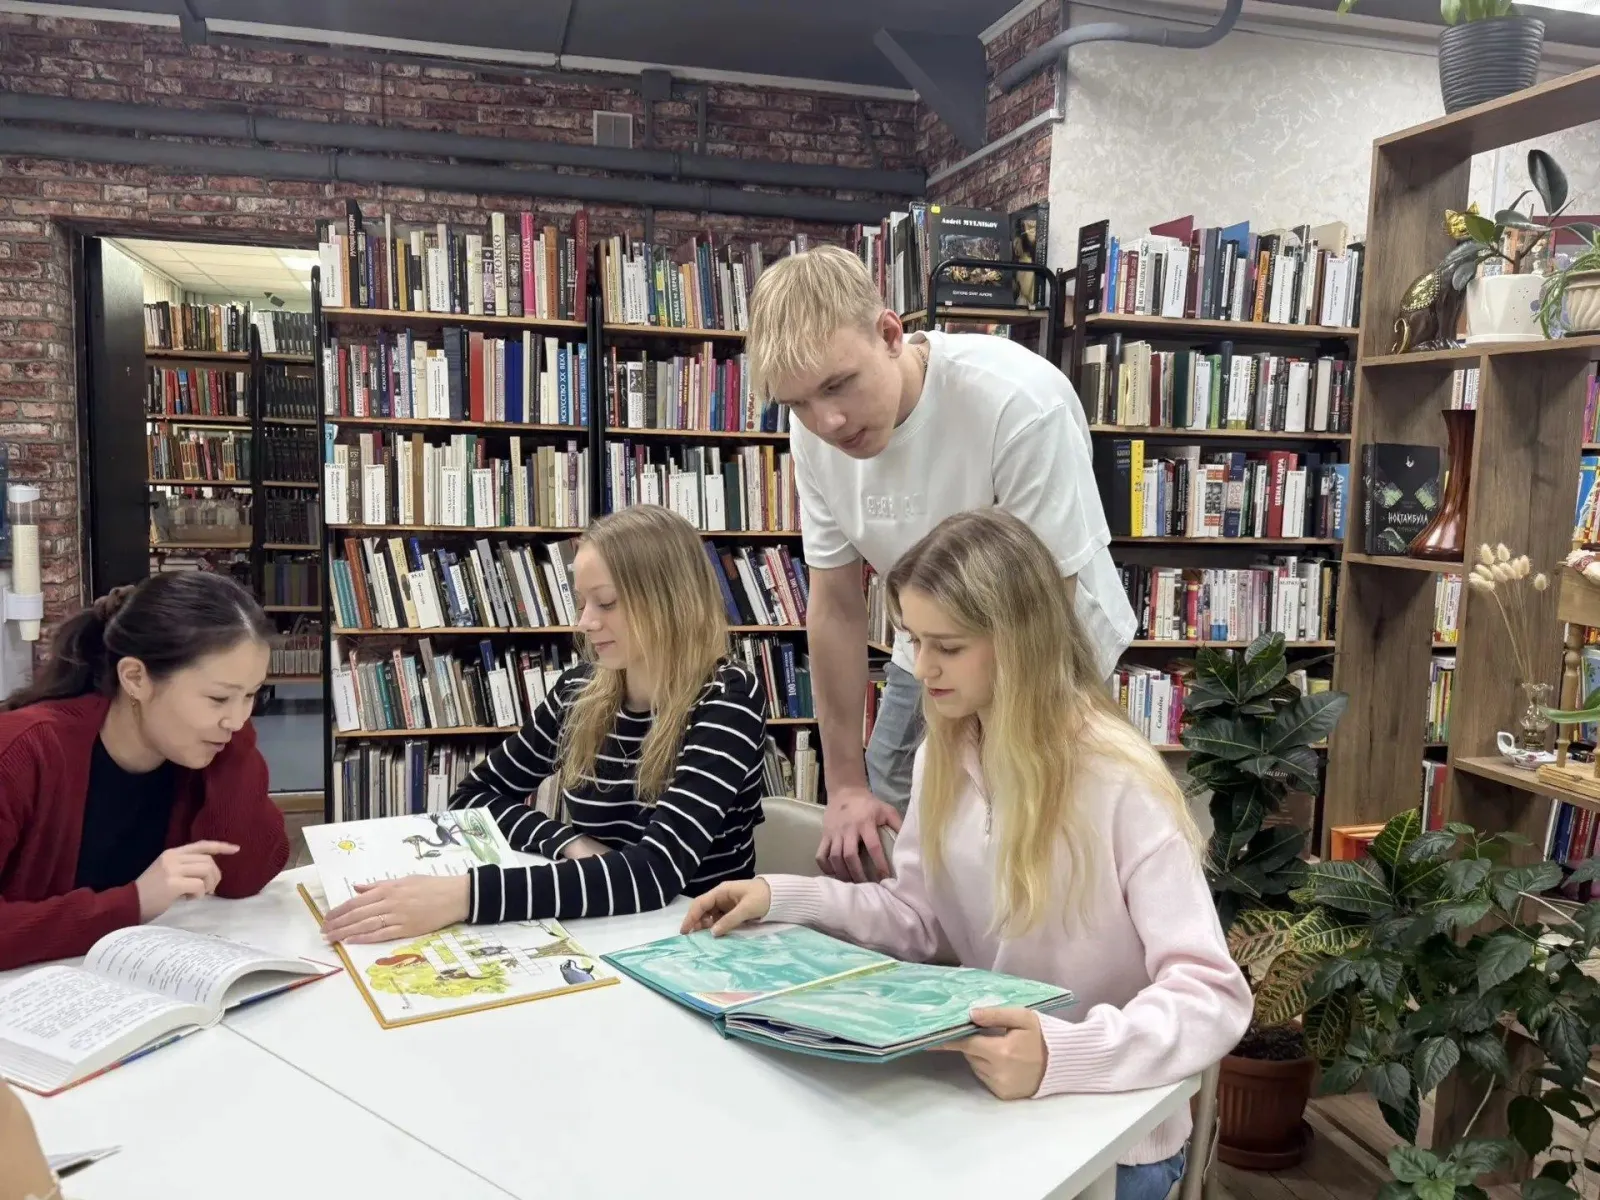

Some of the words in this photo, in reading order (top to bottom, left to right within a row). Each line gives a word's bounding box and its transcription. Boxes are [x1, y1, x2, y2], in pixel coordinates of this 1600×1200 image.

[963, 220, 998, 228] MYLNIKOV
[494, 234, 503, 288] БАРОККО
[523, 236, 531, 272] ГОТИКА
[560, 372, 566, 382] XX
[1250, 359, 1258, 395] ЗЫКИНА
[1276, 458, 1284, 484] КАДРА
[1334, 474, 1345, 530] Актеры
[1388, 511, 1428, 524] НОКТАМБУЛА
[789, 577, 797, 588] 100
[788, 683, 796, 696] 100
